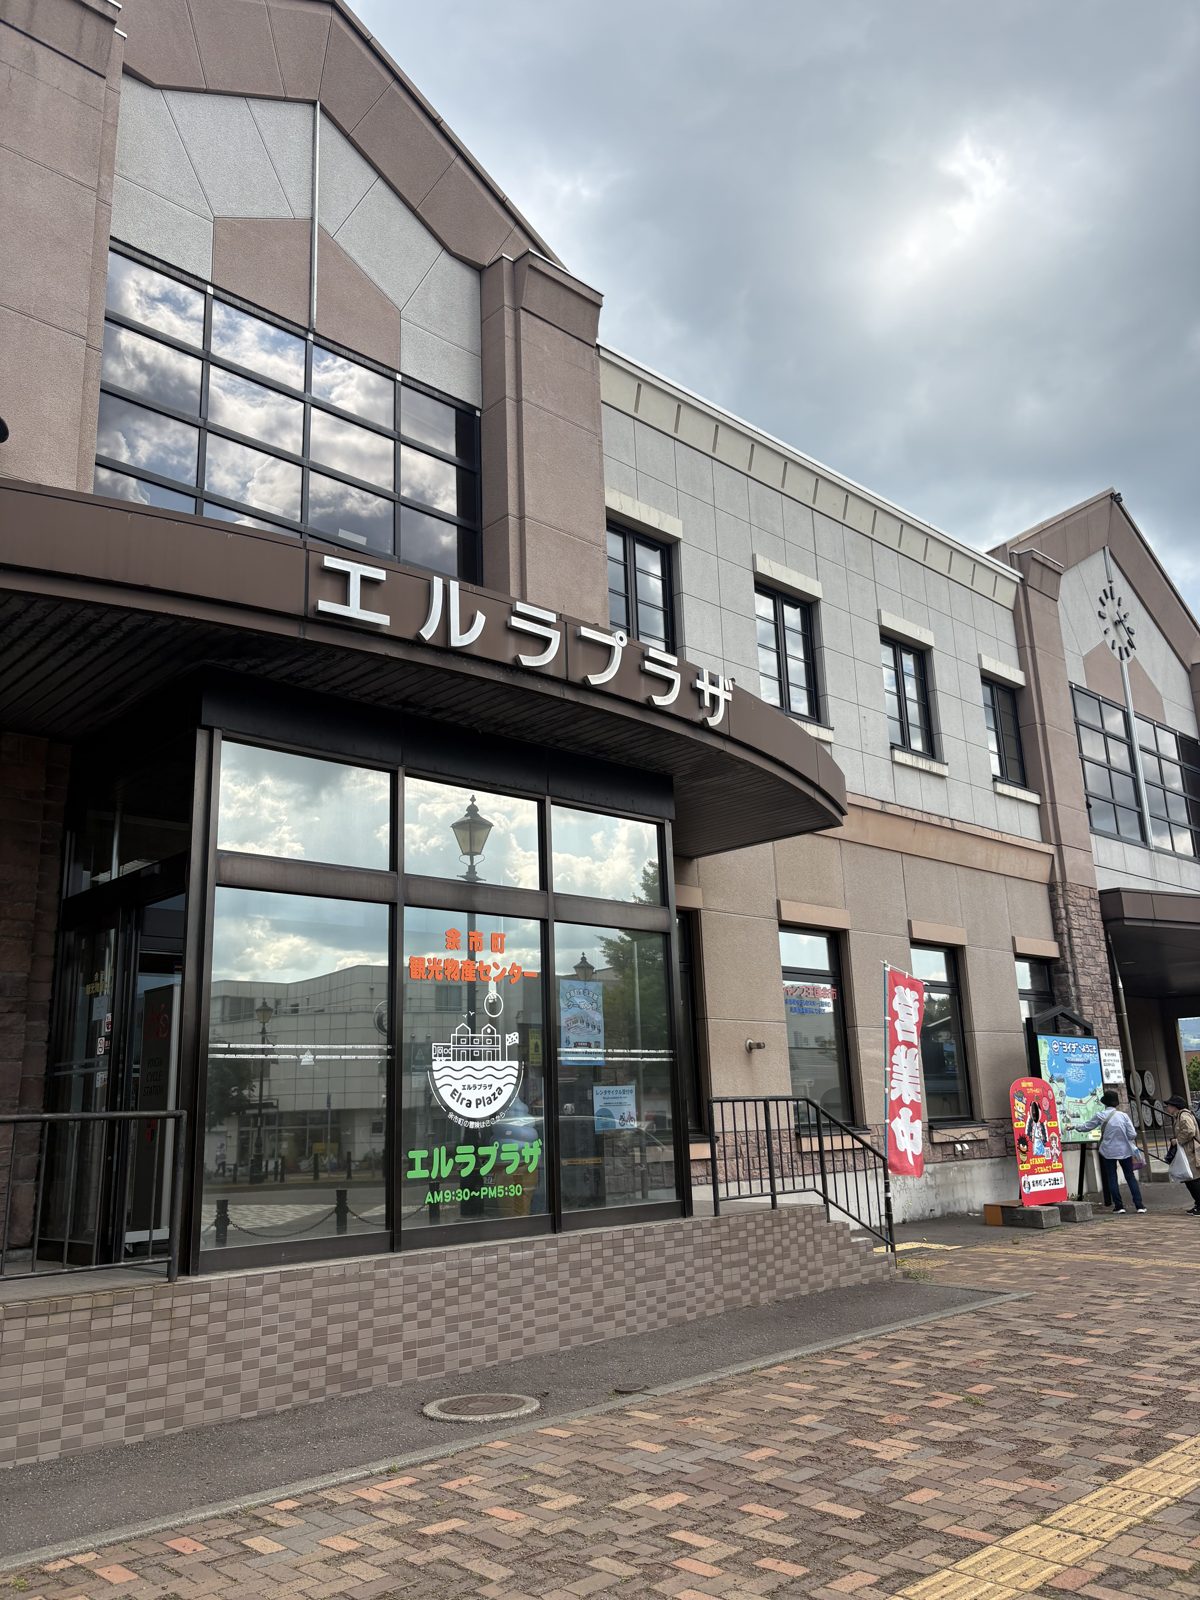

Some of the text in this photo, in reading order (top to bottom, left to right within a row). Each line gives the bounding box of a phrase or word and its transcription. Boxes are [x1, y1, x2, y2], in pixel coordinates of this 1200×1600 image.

[316, 555, 734, 726] エルラプラザ
[445, 928, 506, 953] 余市町
[409, 956, 538, 984] 観光物産センター
[461, 1083, 493, 1091] エルラプラザ
[890, 985, 923, 1166] 営業中
[449, 1086, 504, 1108] Elra Plaza
[406, 1139, 543, 1180] エルラプラザ
